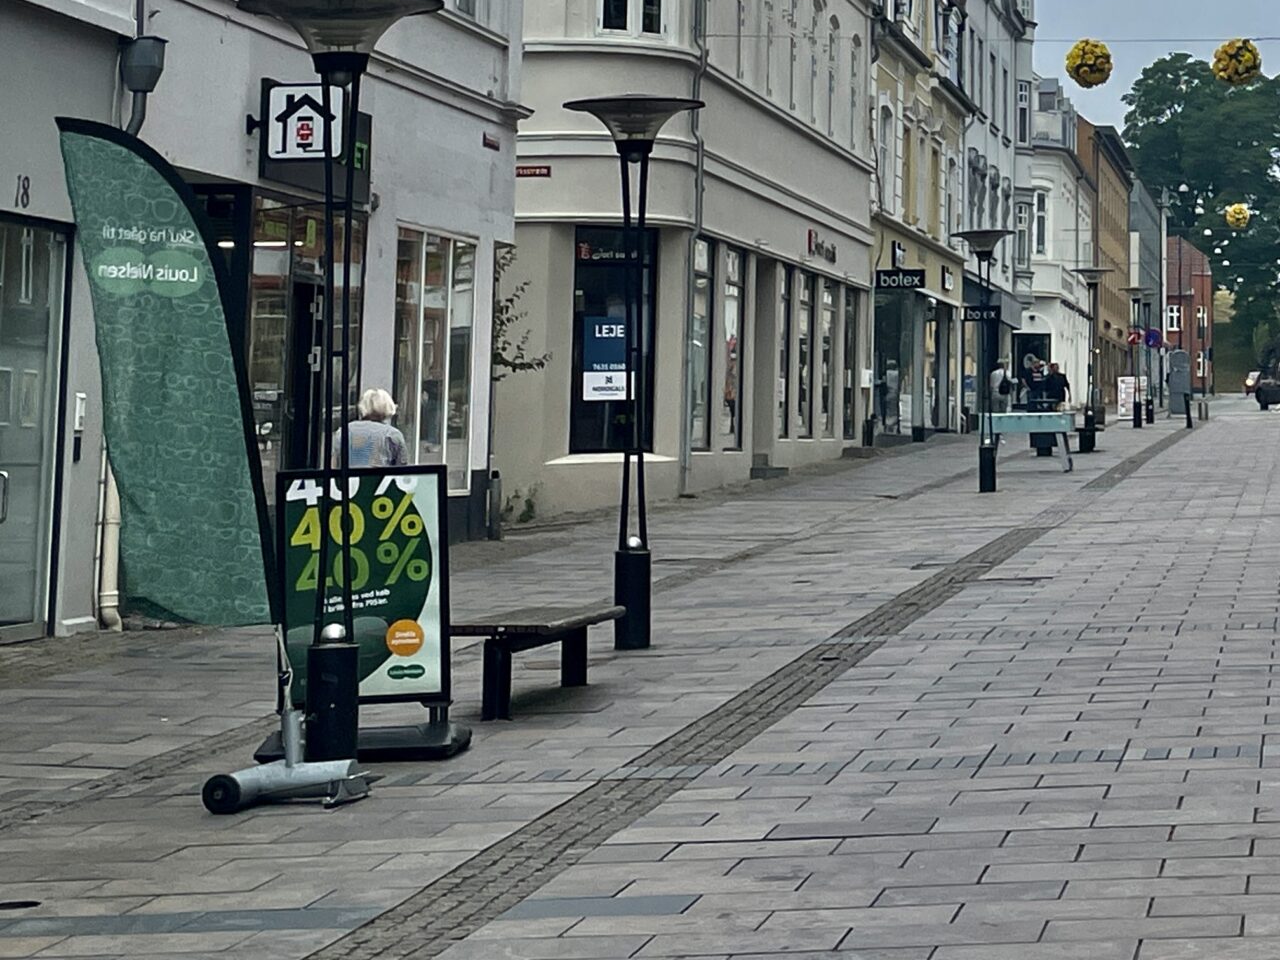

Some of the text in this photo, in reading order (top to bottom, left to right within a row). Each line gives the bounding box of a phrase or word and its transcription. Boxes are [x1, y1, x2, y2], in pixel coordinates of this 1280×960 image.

[14, 174, 30, 209] 18
[880, 272, 921, 287] botex
[966, 305, 997, 319] boex
[595, 325, 625, 338] LEJE
